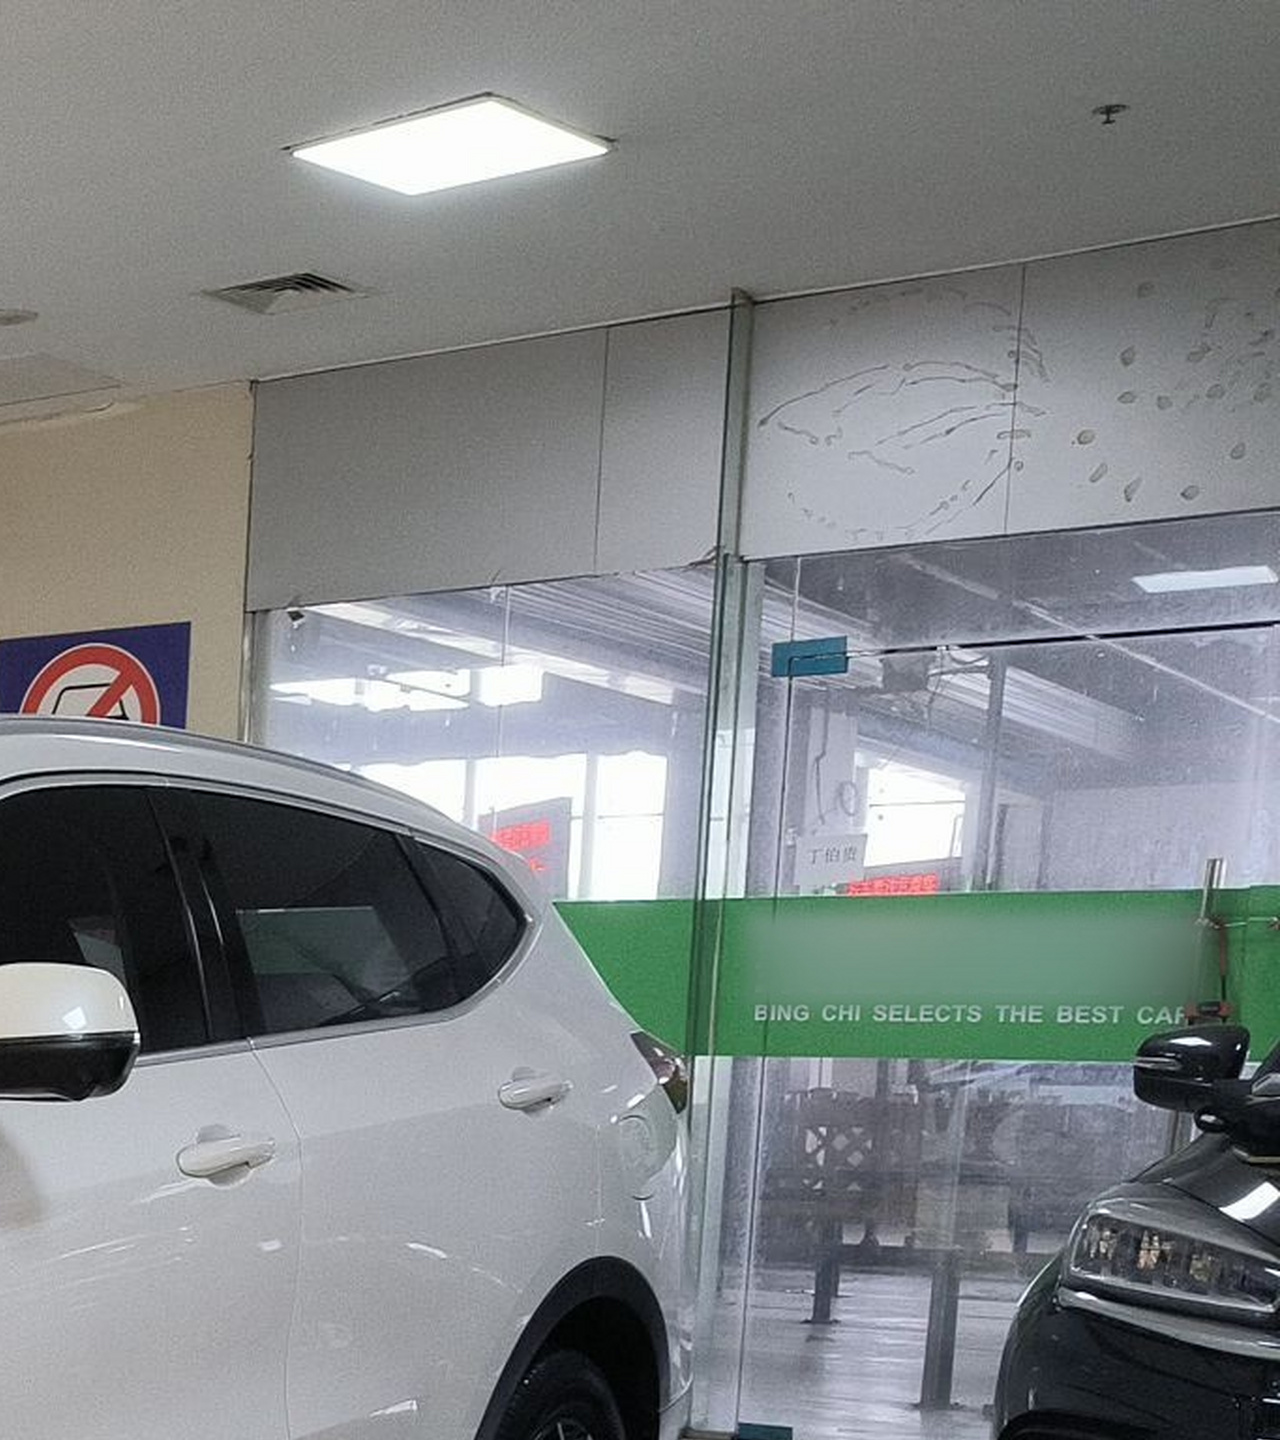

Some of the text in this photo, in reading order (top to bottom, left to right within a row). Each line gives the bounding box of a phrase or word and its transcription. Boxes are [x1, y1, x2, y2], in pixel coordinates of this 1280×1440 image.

[754, 1004, 810, 1021] BING
[822, 1004, 860, 1021] CHI
[872, 1004, 982, 1022] SELECTS
[995, 1005, 1043, 1023] THE
[1056, 1005, 1124, 1023] BEST
